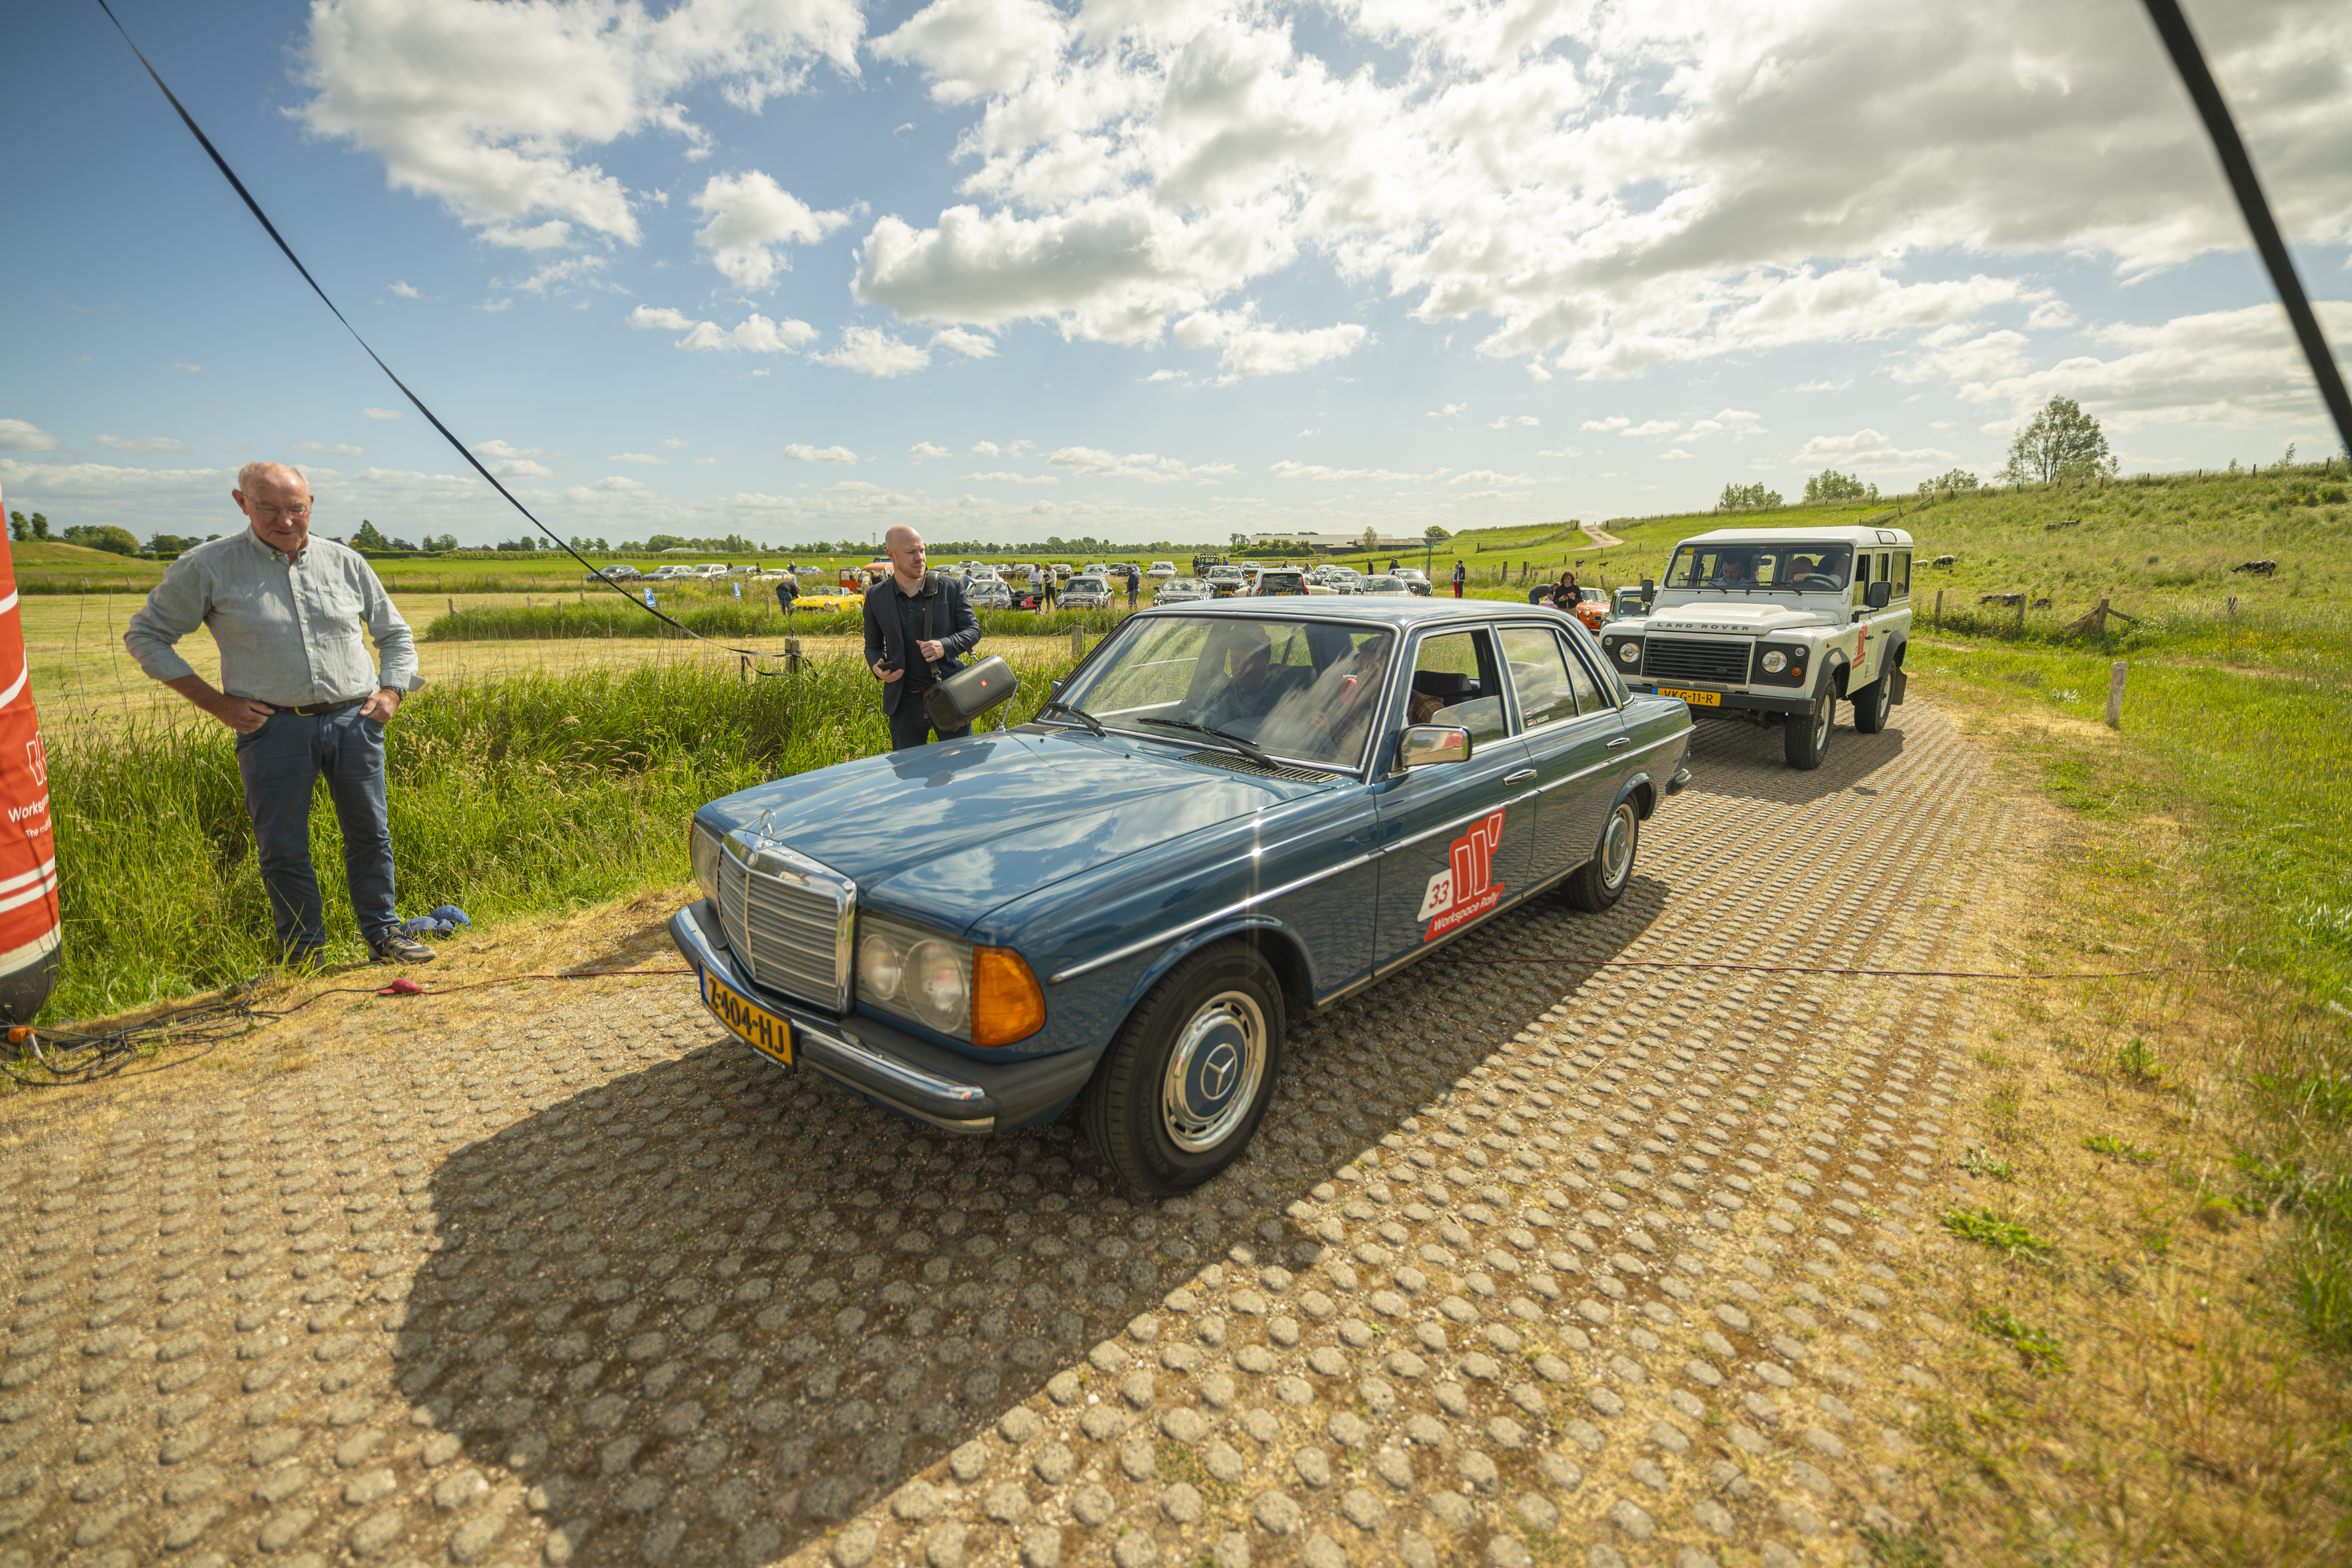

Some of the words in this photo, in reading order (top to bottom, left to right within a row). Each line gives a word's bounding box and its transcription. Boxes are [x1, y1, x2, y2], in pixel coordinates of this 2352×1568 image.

[1664, 690, 1714, 705] VKG-11-R
[25, 828, 39, 839] The
[1428, 879, 1450, 910] 33
[1433, 901, 1480, 932] Workspace
[1479, 891, 1500, 910] Rally
[709, 977, 785, 1055] Z-404-HJ
